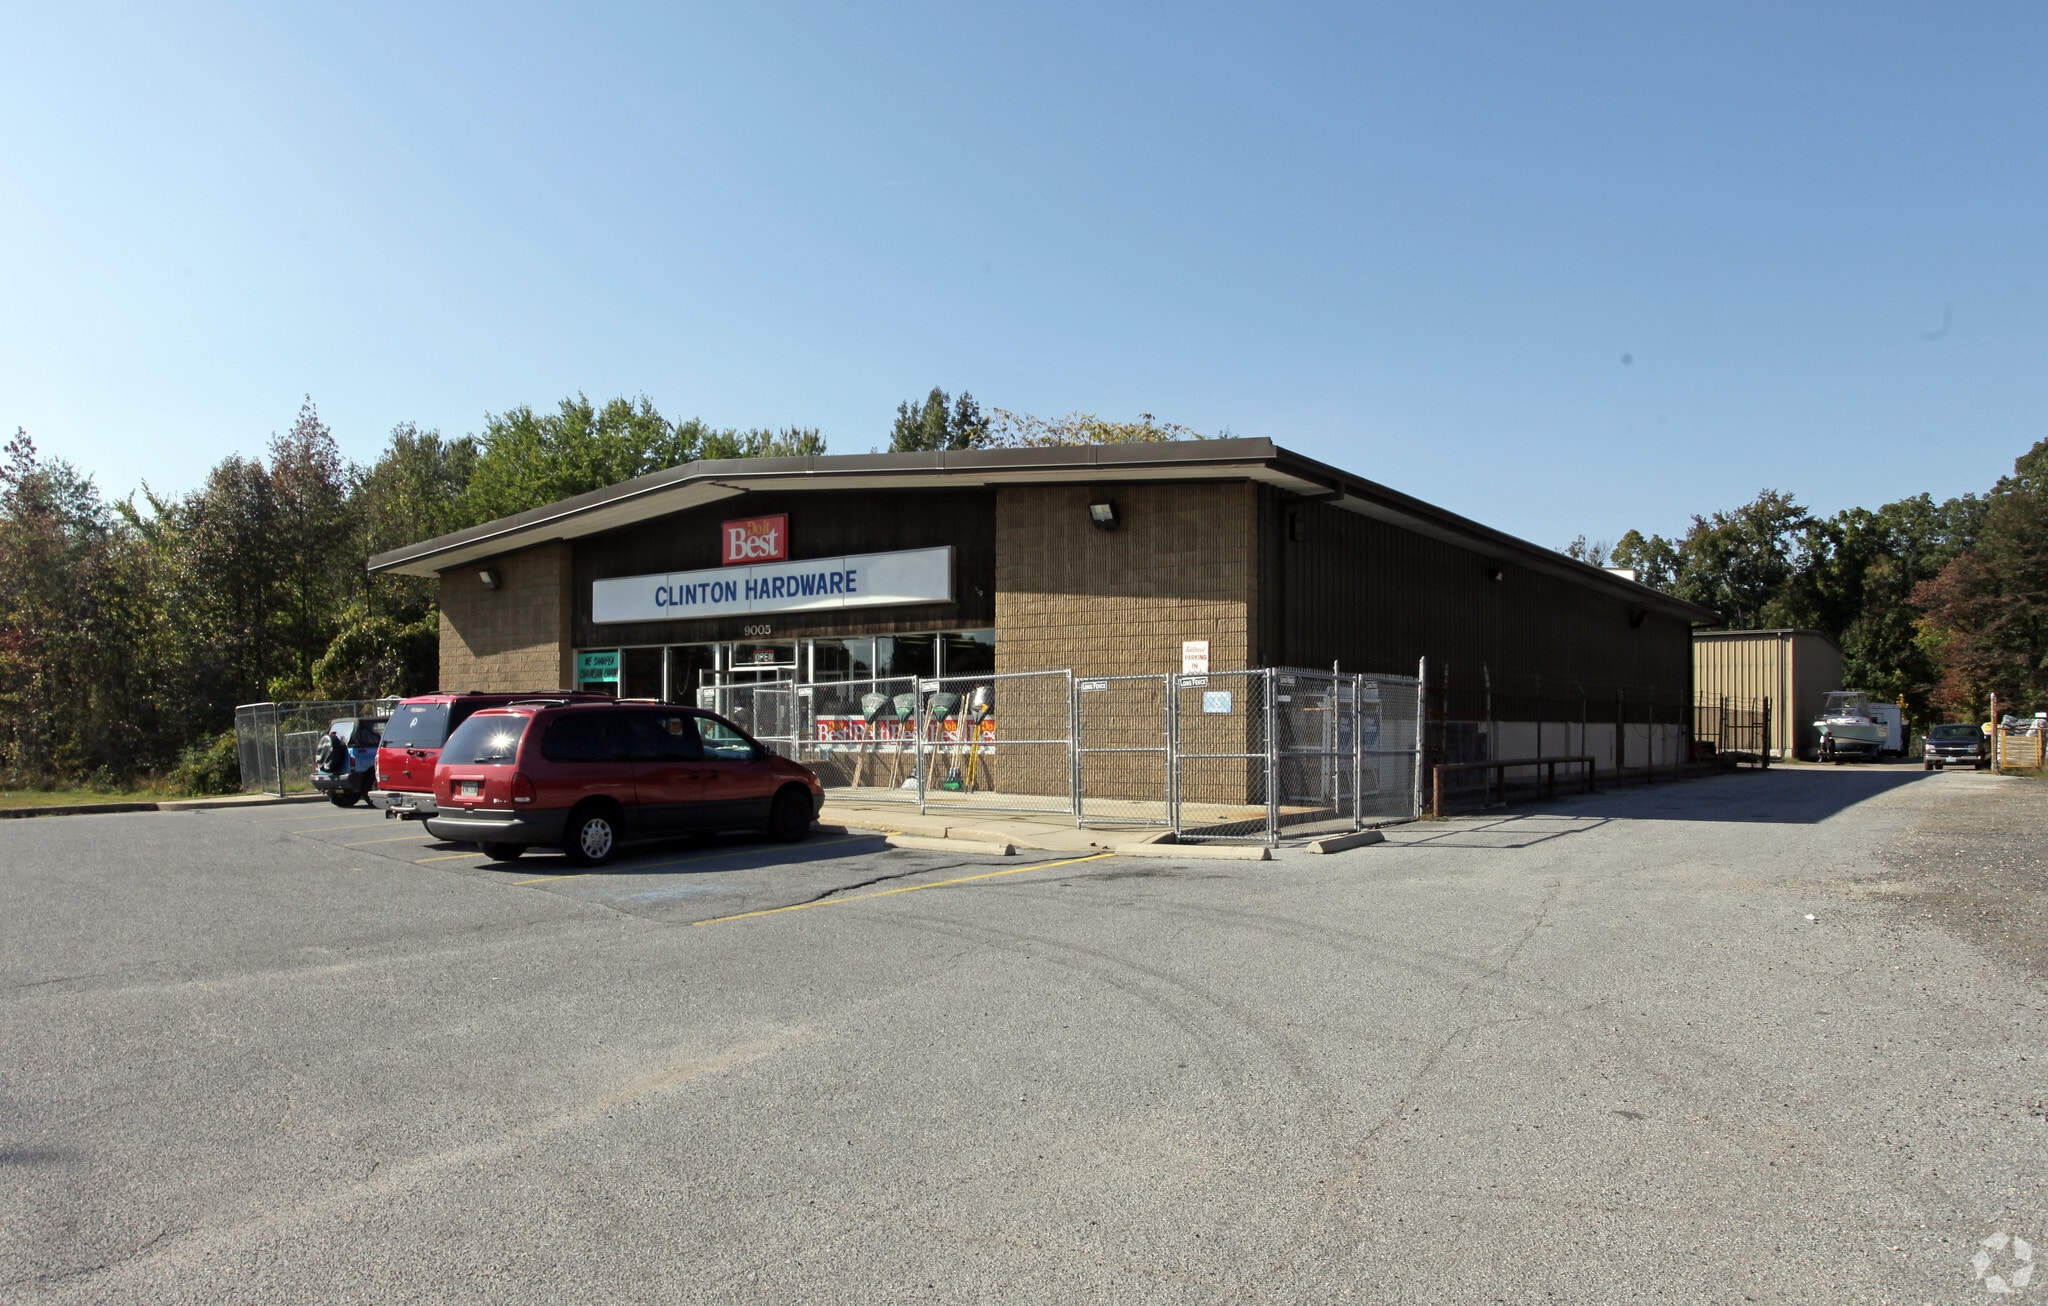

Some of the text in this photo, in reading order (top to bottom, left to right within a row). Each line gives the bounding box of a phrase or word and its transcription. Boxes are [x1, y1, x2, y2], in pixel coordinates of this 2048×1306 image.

[728, 527, 779, 560] Best
[655, 569, 857, 608] CLINTON HARDWARE
[744, 624, 771, 636] 9005
[755, 652, 774, 662] OPEN
